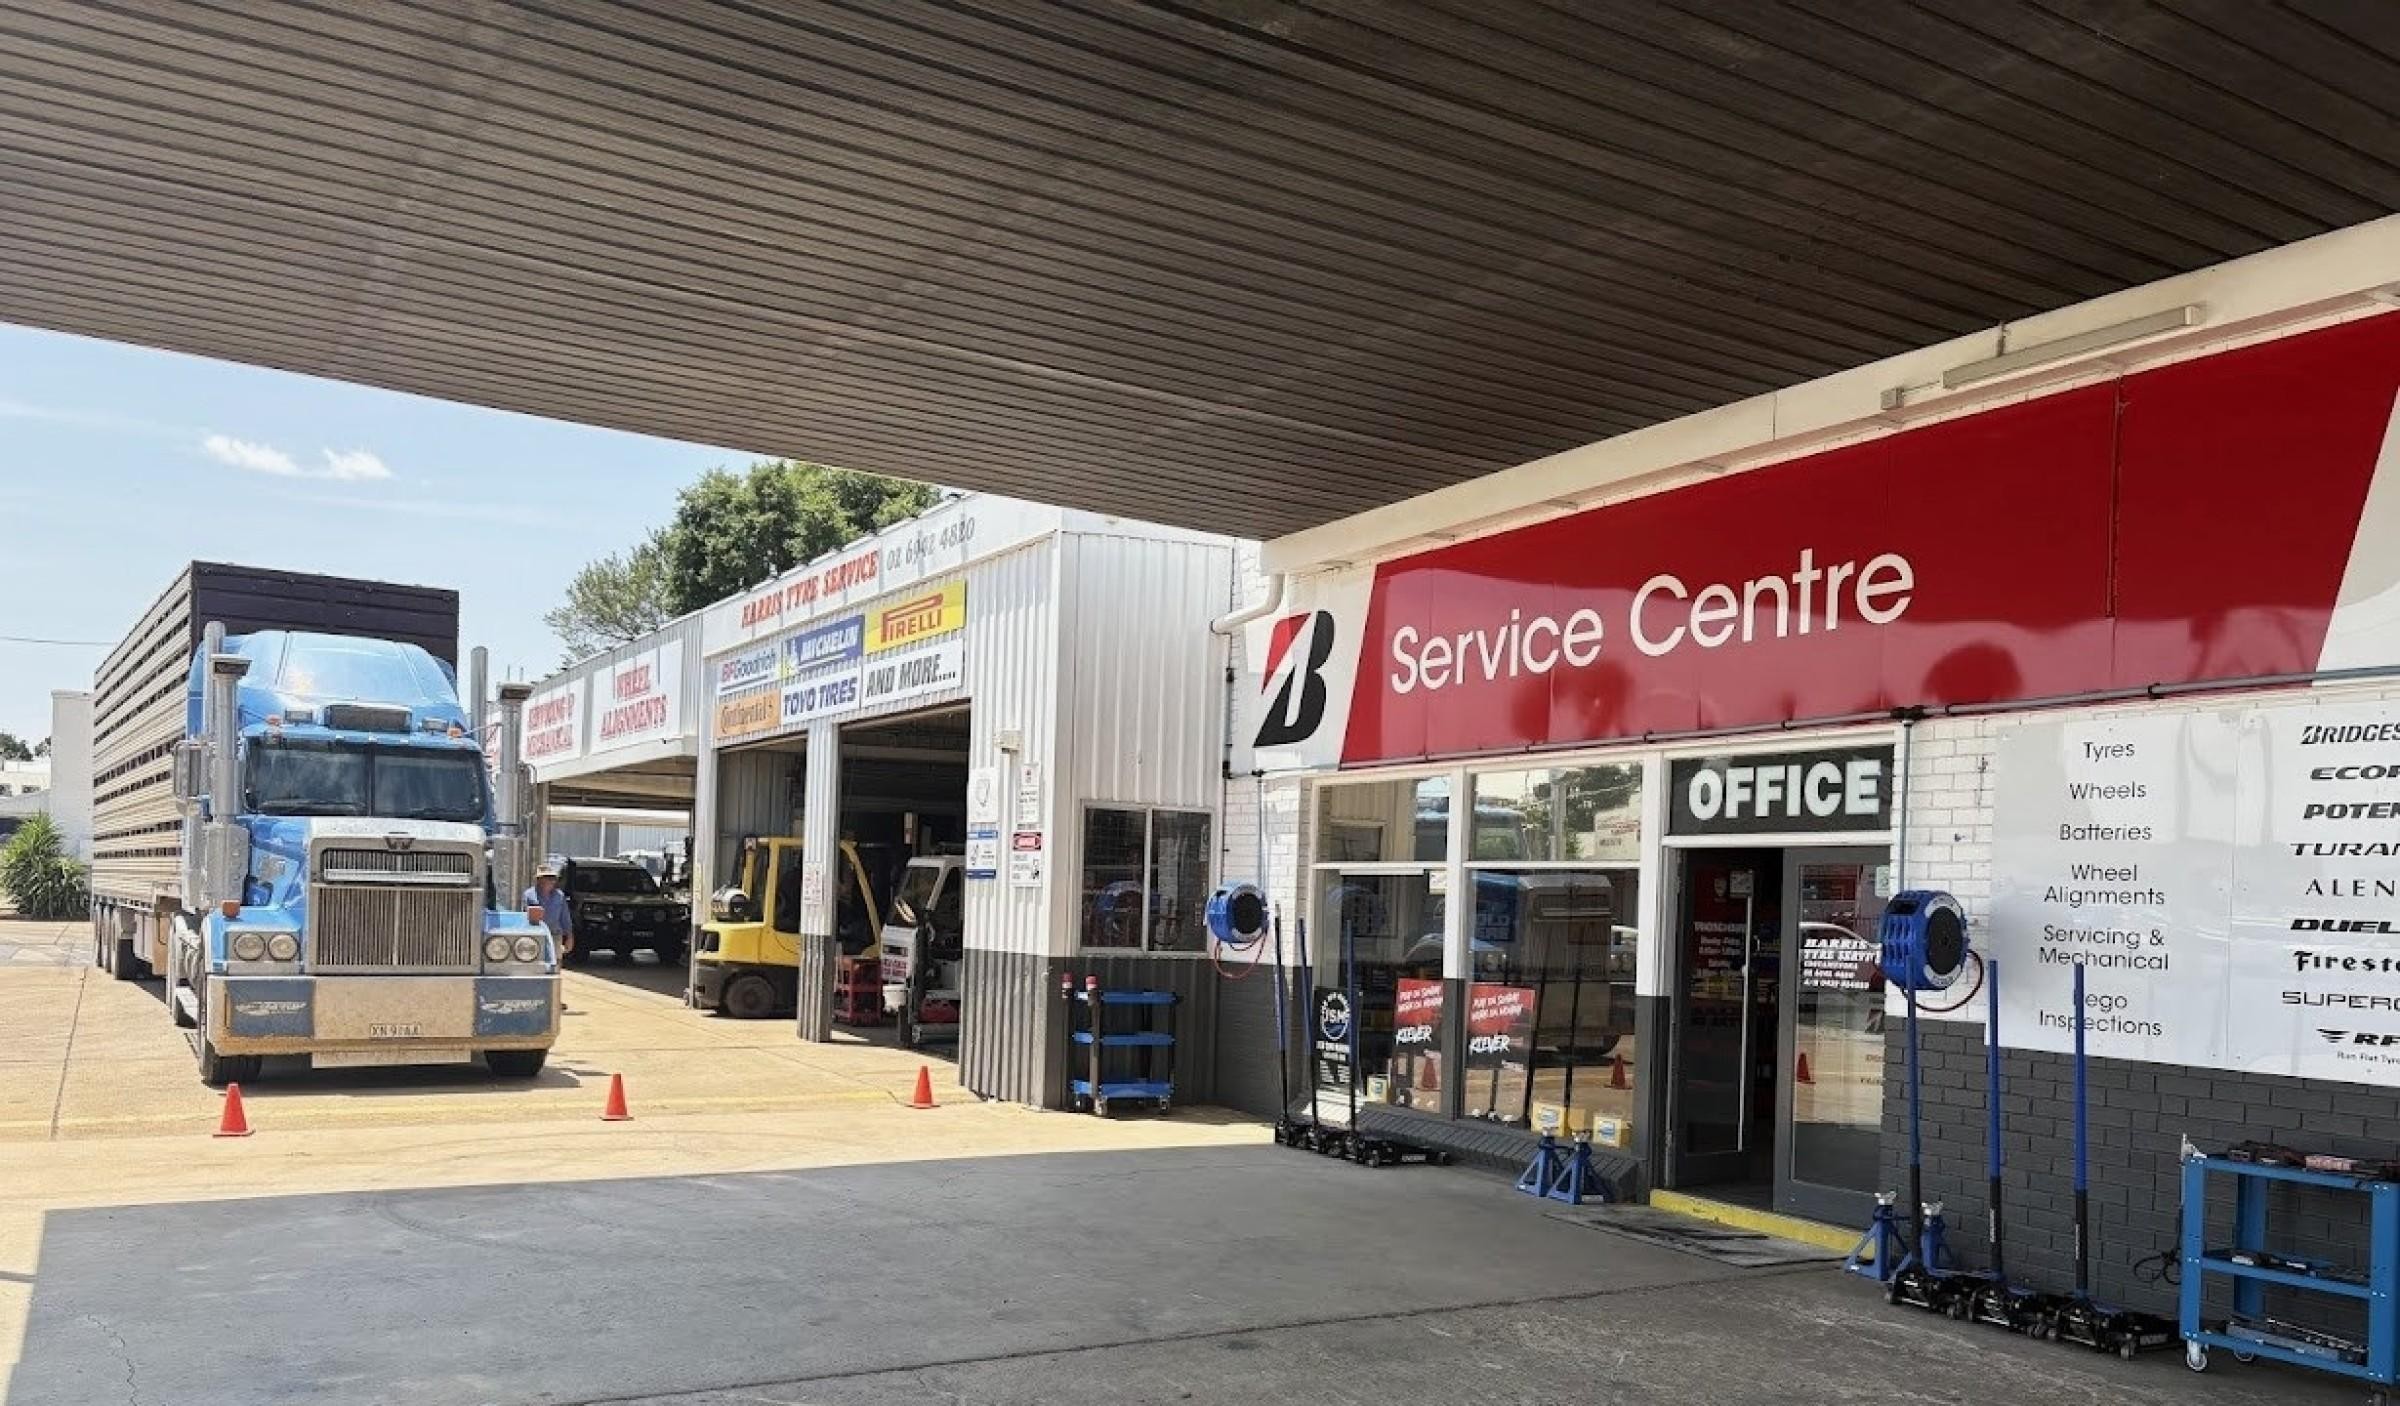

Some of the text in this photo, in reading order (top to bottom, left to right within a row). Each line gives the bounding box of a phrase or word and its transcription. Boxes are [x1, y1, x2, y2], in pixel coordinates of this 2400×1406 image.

[786, 575, 818, 611] TYRE
[824, 550, 878, 599] SERVICE
[881, 593, 944, 643] PIRELLI
[1391, 548, 1915, 694] Service Centre
[801, 624, 860, 662] MICHELIN
[722, 648, 777, 682] BFGoodrich
[616, 664, 651, 700] WHEEL
[866, 666, 896, 698] AND
[784, 677, 858, 717] TOYO TIRES
[600, 694, 667, 740] ALIGNMENTS
[720, 696, 768, 735] Continental
[2083, 741, 2136, 763] Tyres
[1688, 759, 1882, 821] OFFICE
[2069, 781, 2148, 800] Wheels
[2059, 823, 2153, 841] Batteries
[2071, 864, 2138, 882] Wheel
[2306, 878, 2395, 897] ALEN
[2044, 885, 2165, 909] Alignments
[1804, 938, 1868, 950] HARRIS
[2044, 924, 2165, 950] Servicing &
[1804, 949, 1834, 960] TYRE
[2039, 946, 2169, 971] Mechanical
[2074, 990, 2128, 1013] ego
